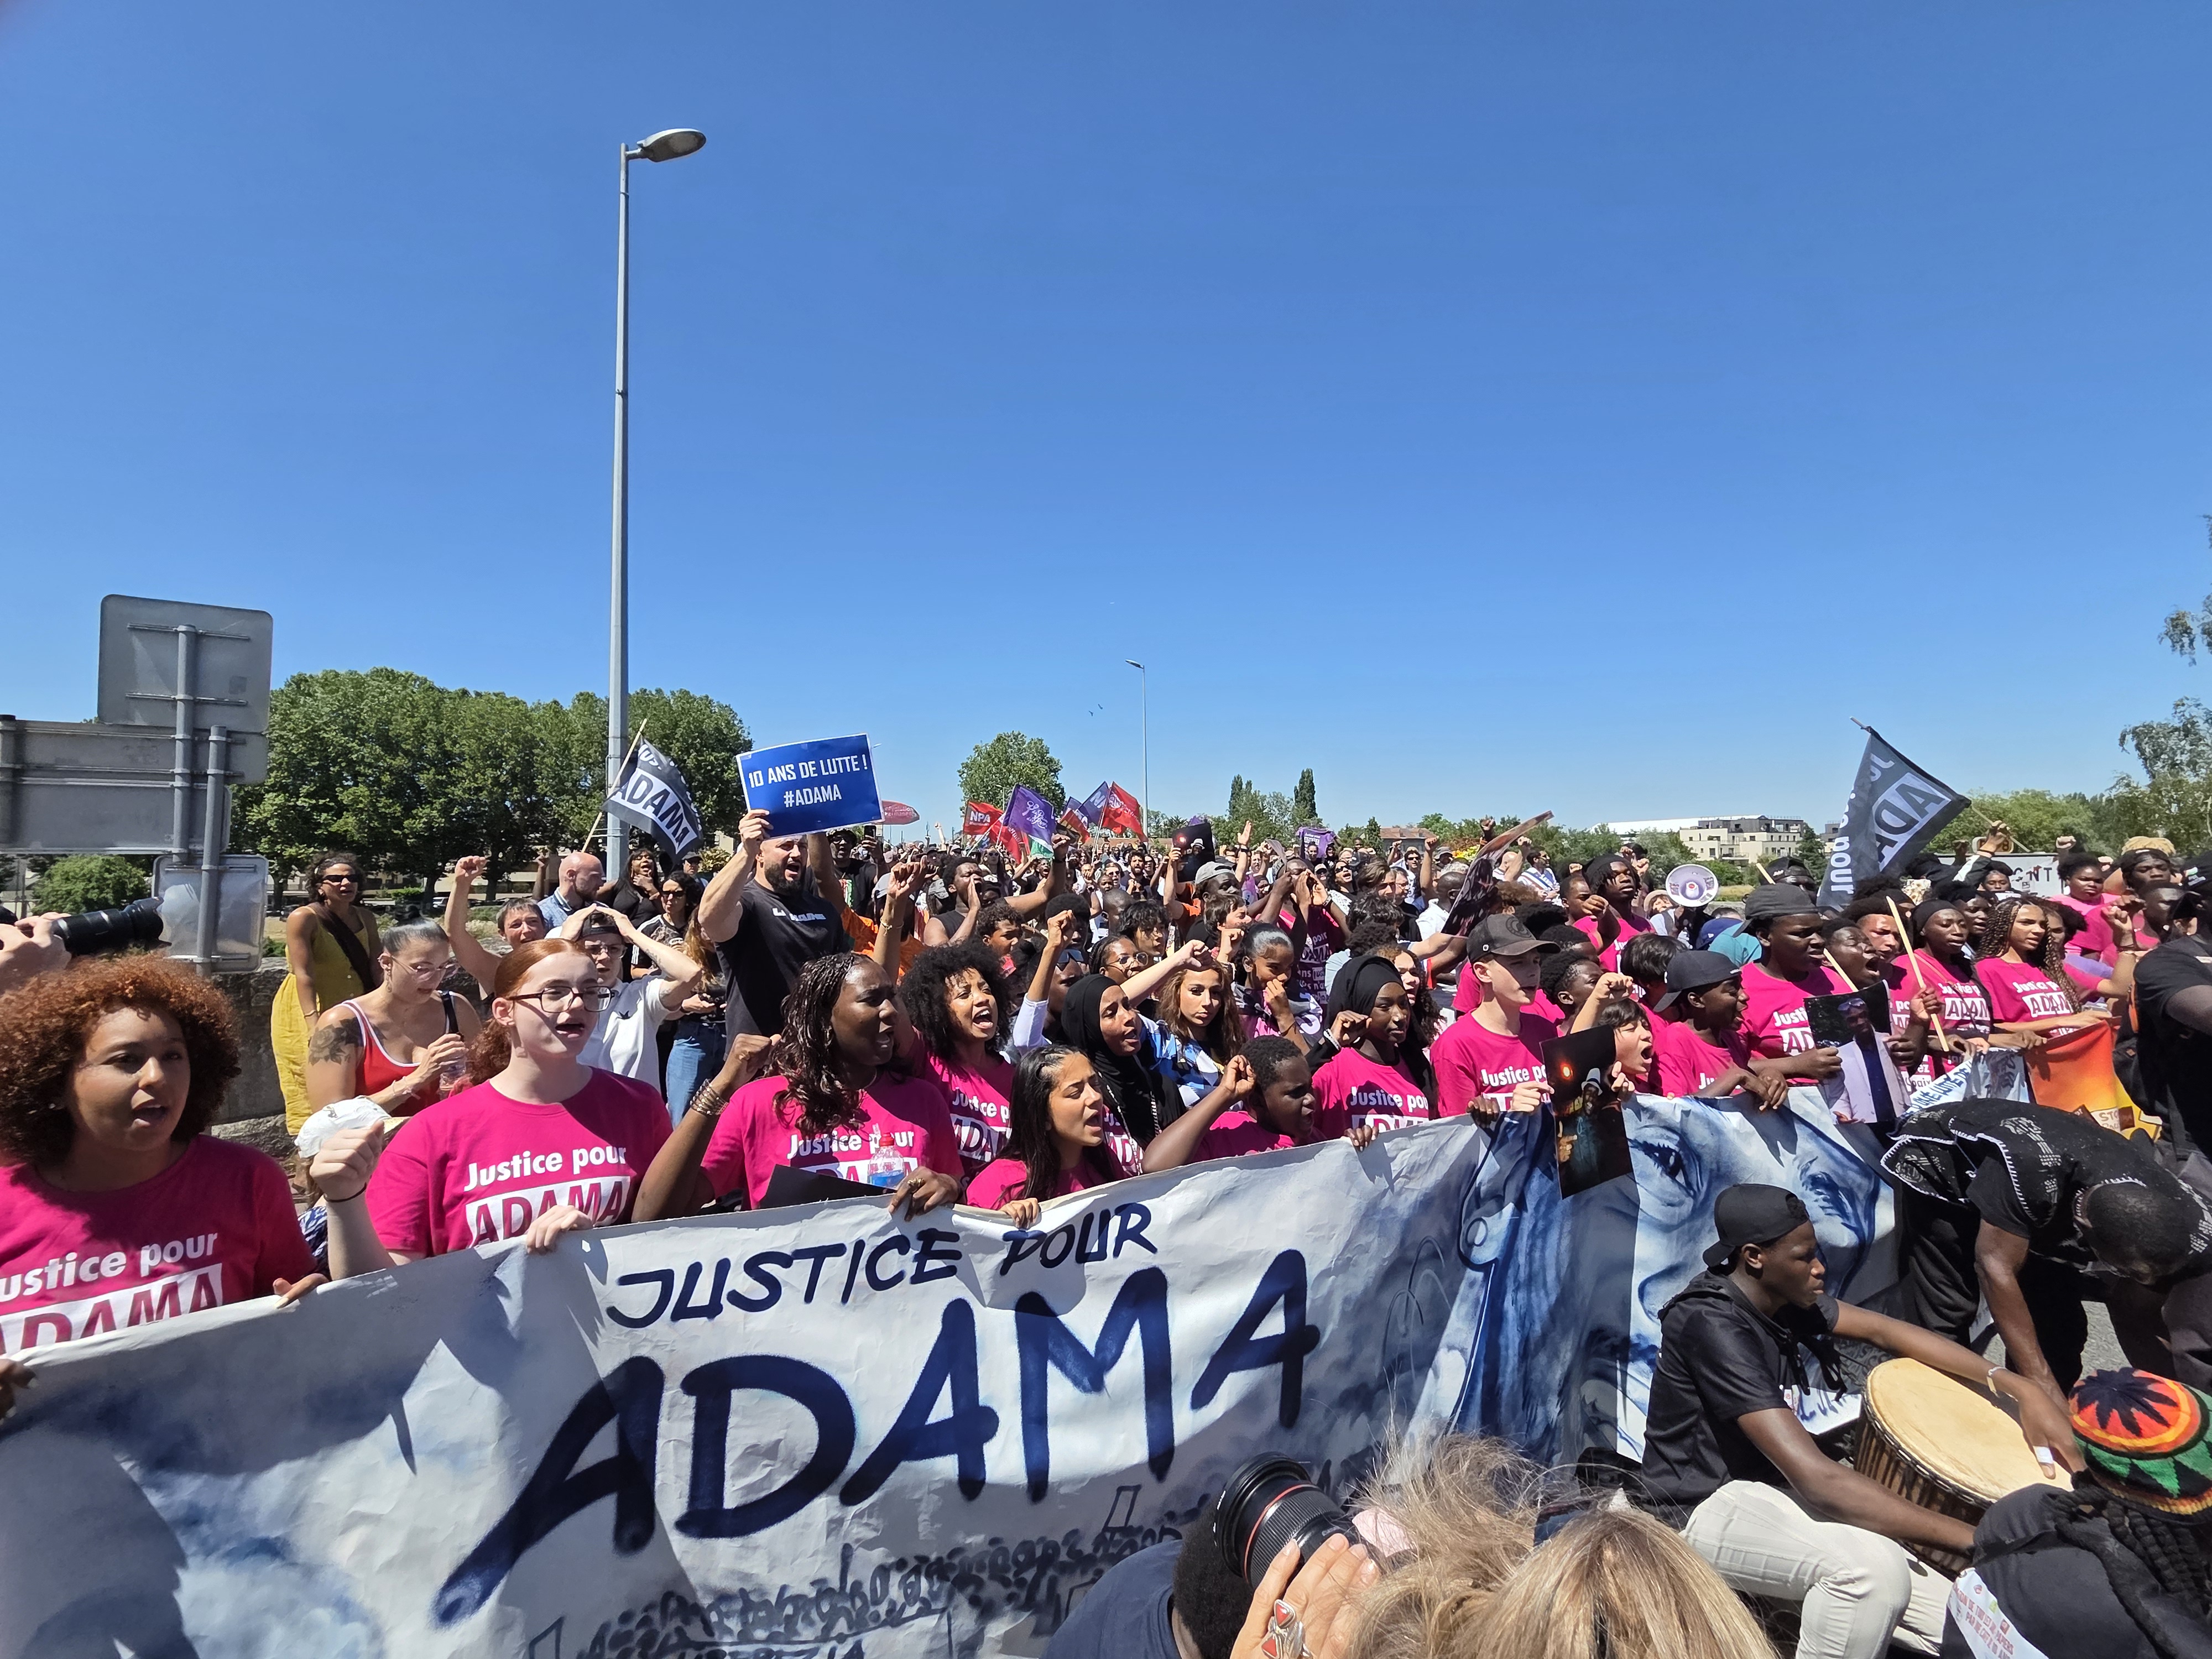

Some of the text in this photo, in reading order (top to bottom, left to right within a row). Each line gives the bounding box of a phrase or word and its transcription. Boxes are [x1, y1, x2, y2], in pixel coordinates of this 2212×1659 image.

[748, 770, 764, 788] 10
[768, 764, 796, 785] ANS
[799, 761, 818, 780] DE
[820, 755, 860, 775] LUTTE
[784, 784, 842, 808] #ADAMA
[969, 811, 990, 823] NPA
[1773, 1007, 1808, 1027] Justi
[1481, 1066, 1530, 1087] Justice
[1350, 1086, 1402, 1108] Justice
[787, 1130, 914, 1159] Justice pur
[464, 1146, 627, 1192] Justice pour
[0, 1232, 218, 1302] ustice pour
[607, 1202, 1159, 1329] JUSTICE POUR
[0, 1272, 219, 1355] DAMA
[434, 1249, 1321, 1629] ADAMA
